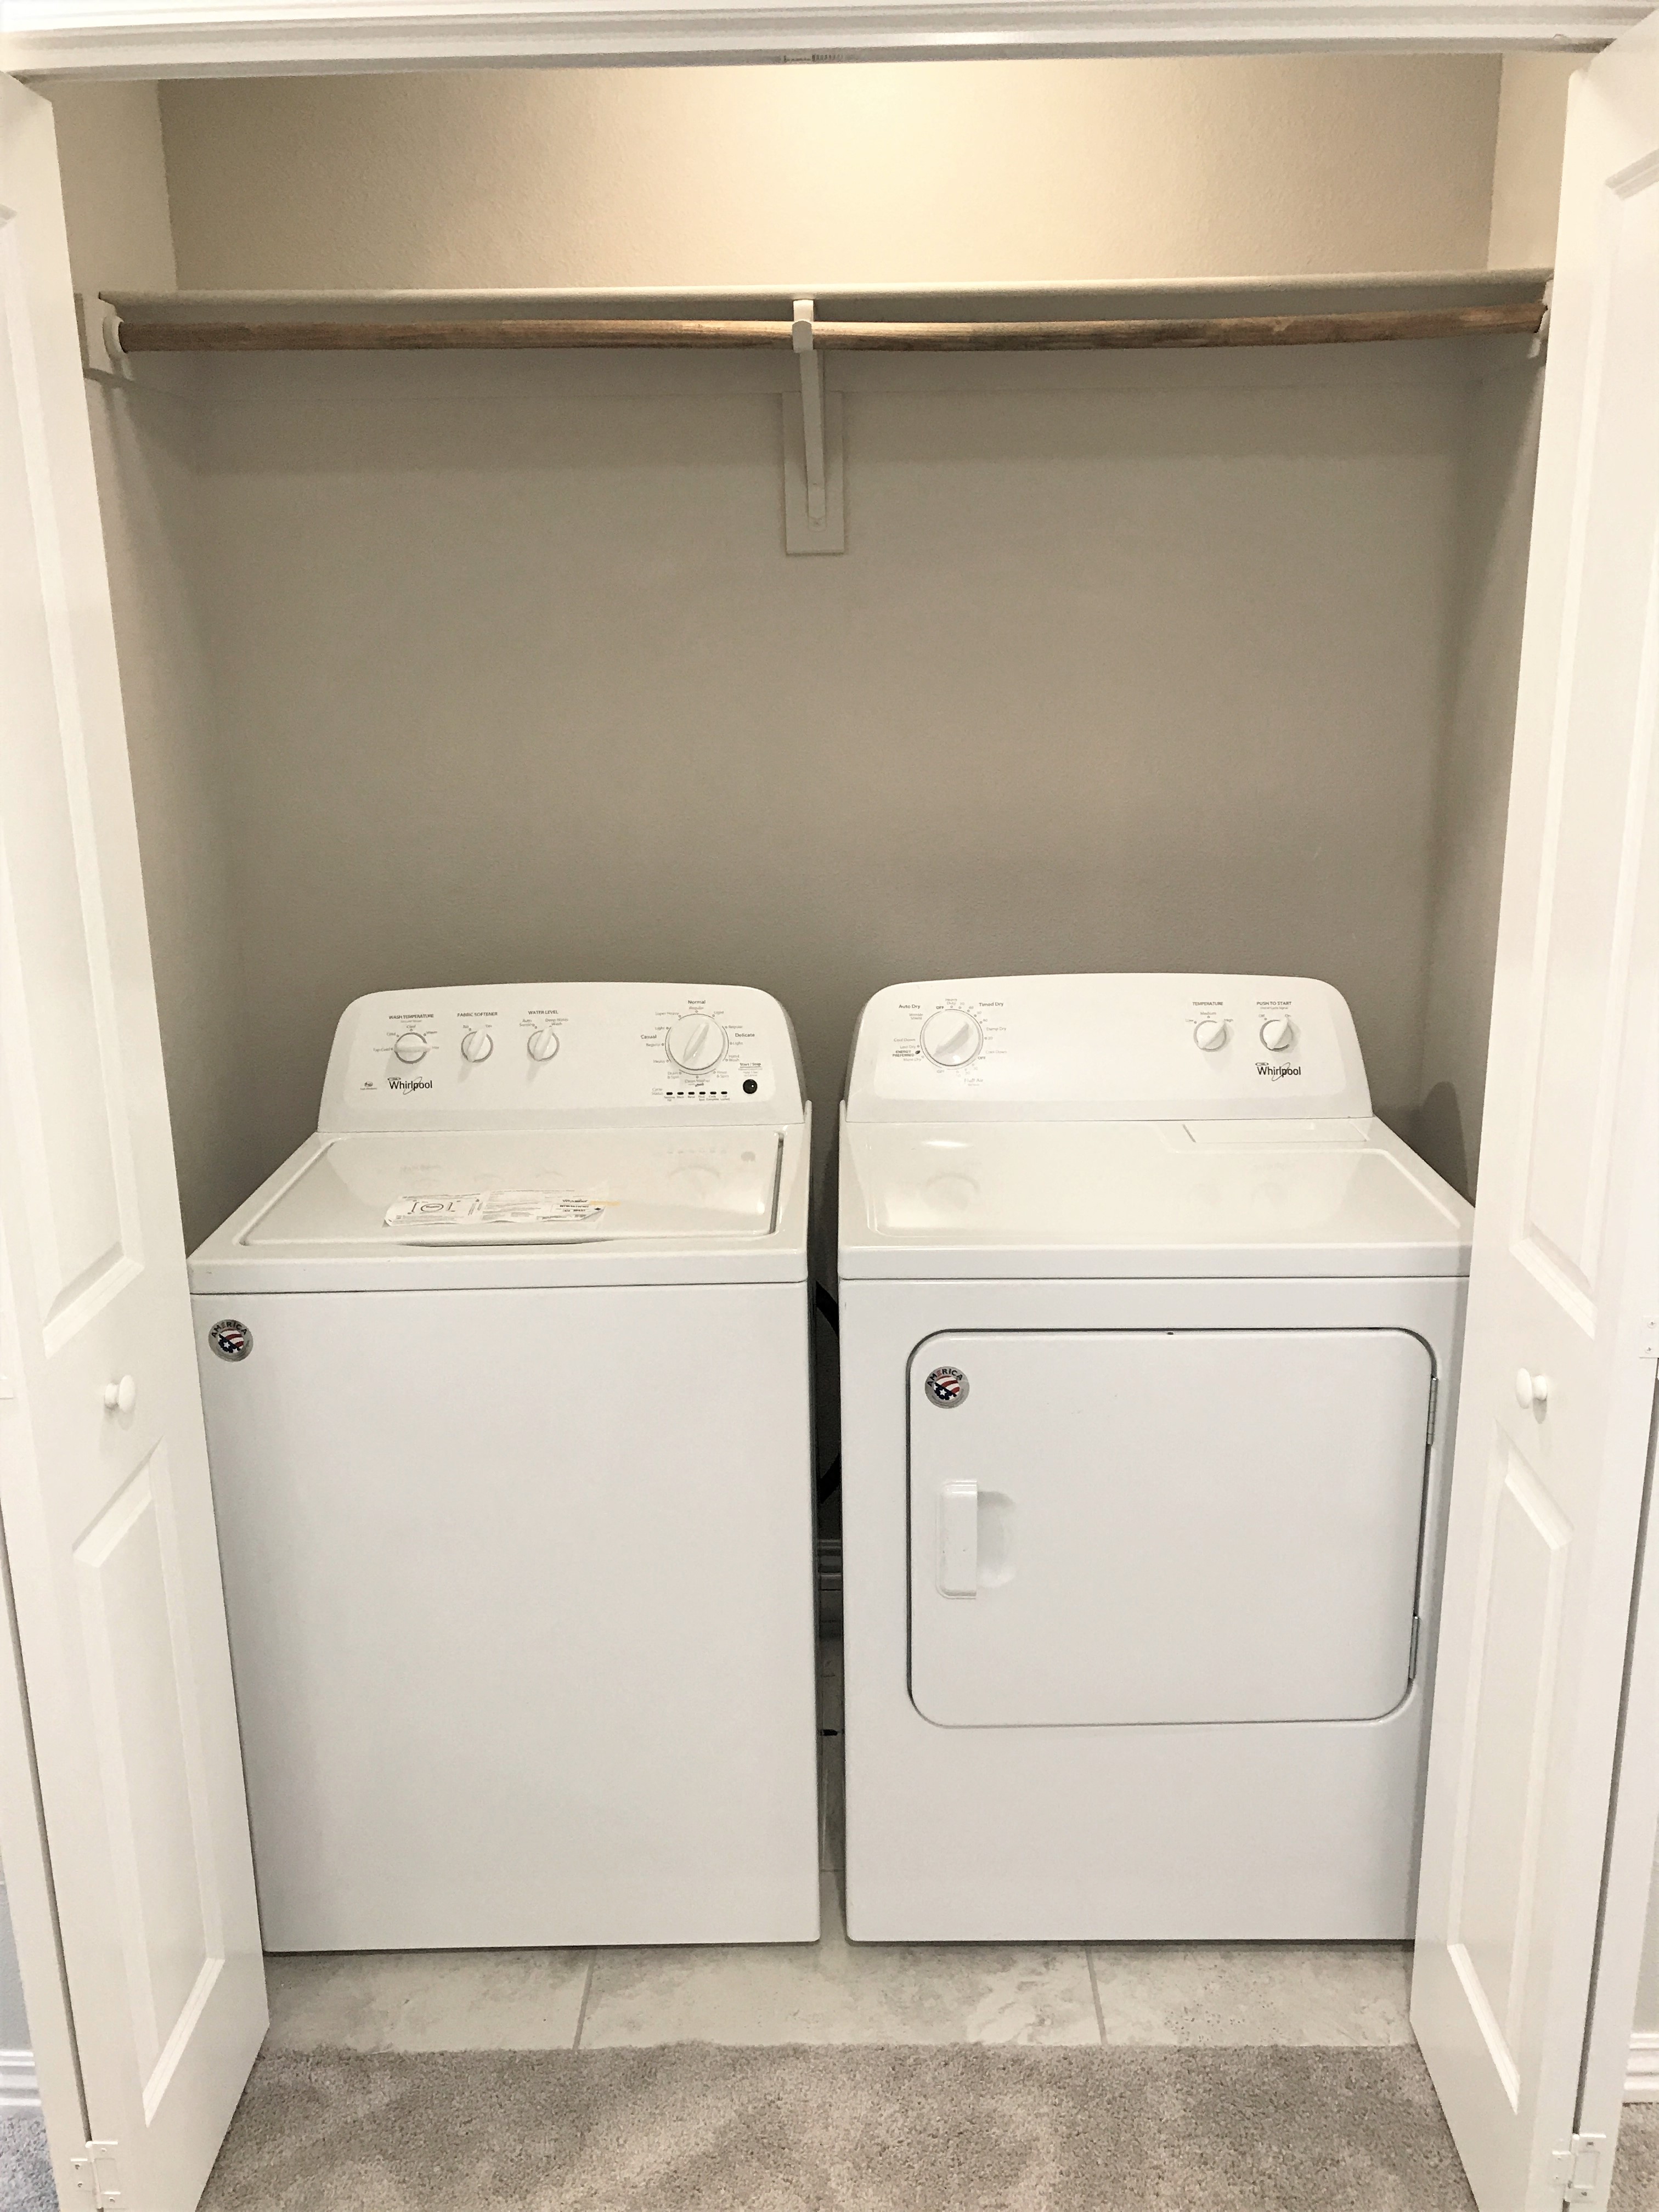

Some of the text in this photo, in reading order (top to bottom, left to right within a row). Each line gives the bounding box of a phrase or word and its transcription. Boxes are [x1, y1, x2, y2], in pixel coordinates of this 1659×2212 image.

[1256, 1066, 1301, 1077] Whirlpool
[389, 1080, 432, 1092] Whirlpool
[211, 1322, 247, 1338] AMERICA
[927, 1368, 963, 1387] AMERICA
